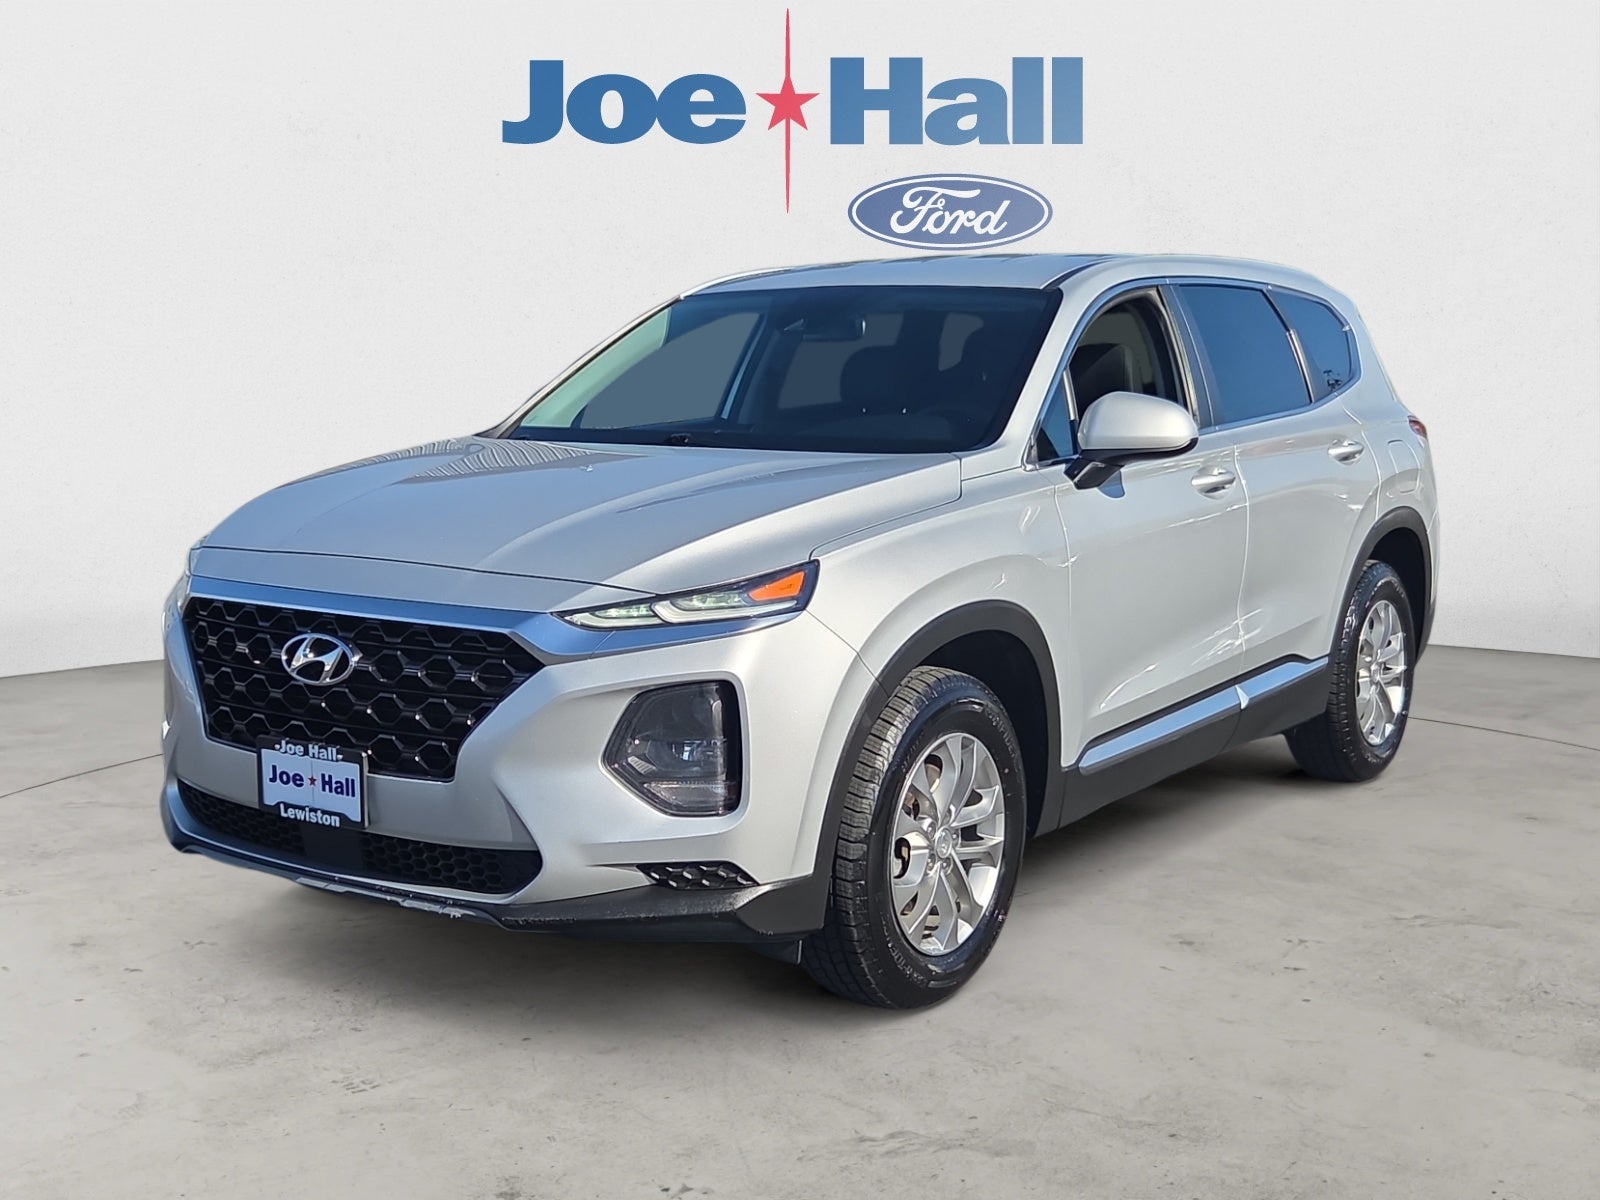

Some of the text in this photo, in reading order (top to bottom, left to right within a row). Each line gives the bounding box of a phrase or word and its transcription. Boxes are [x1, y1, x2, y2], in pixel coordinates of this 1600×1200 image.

[279, 739, 338, 761] Joe Hall
[269, 765, 356, 797] Joe Hall
[280, 803, 341, 827] Lewiston
